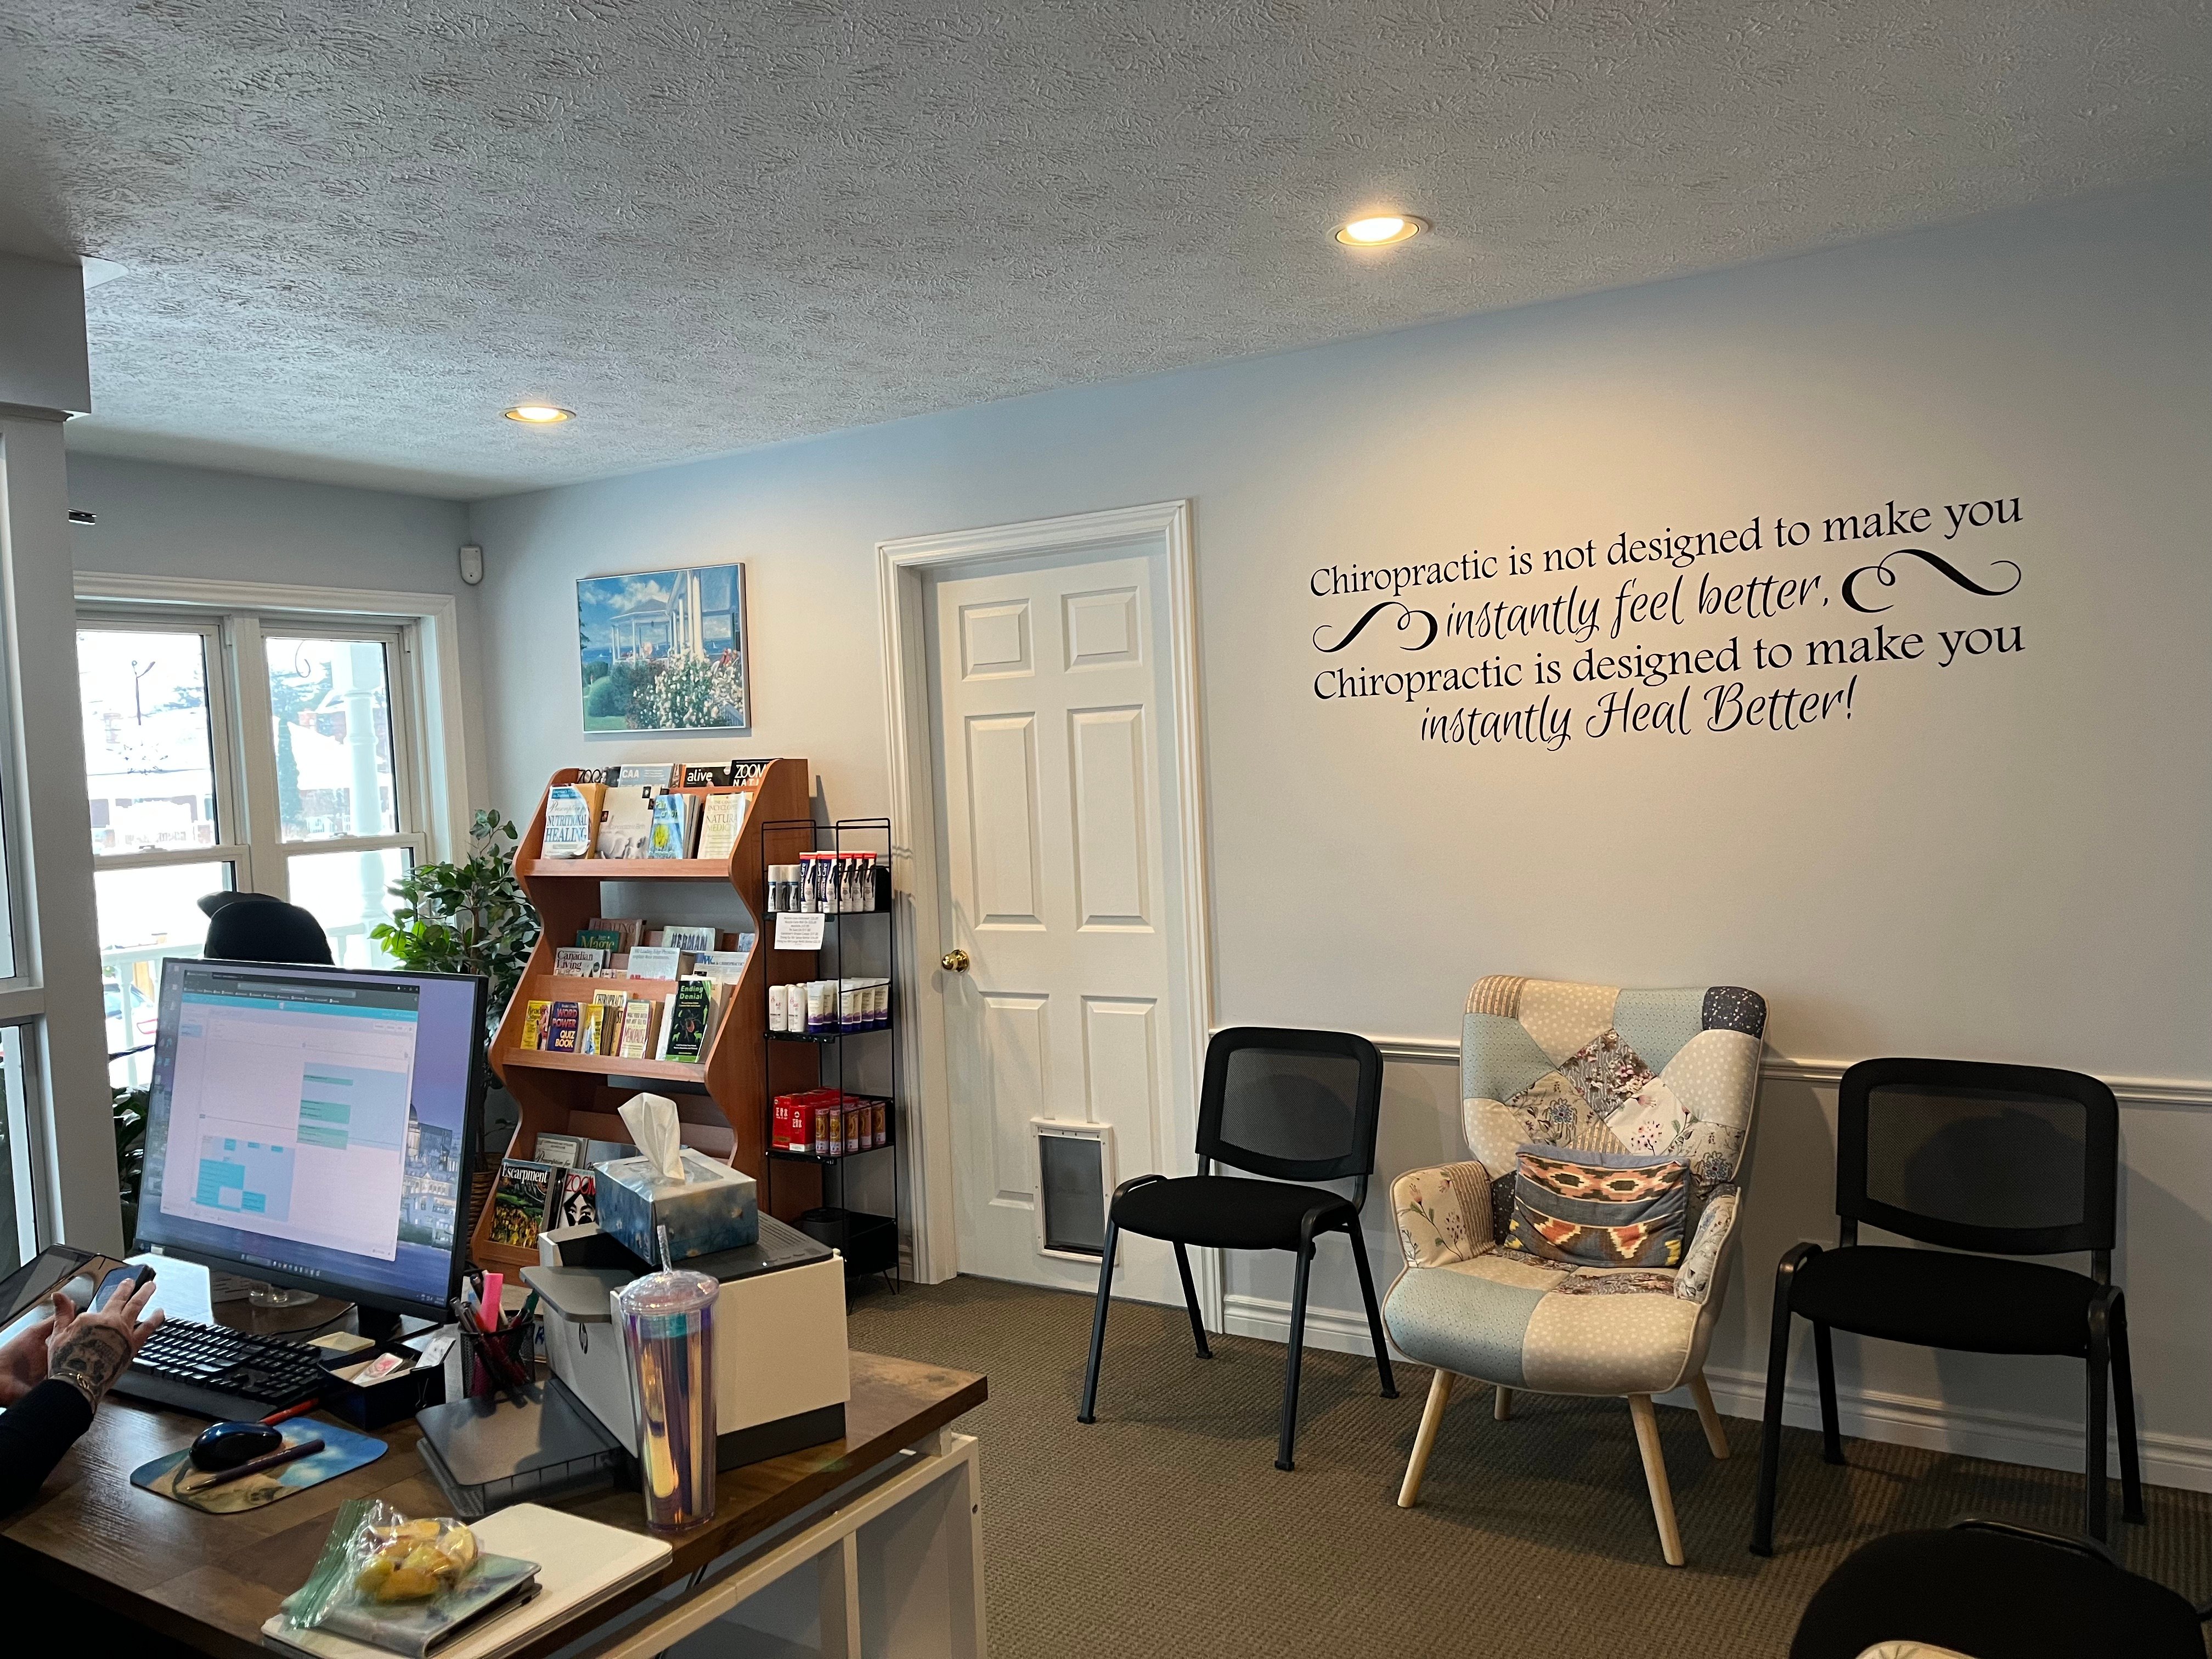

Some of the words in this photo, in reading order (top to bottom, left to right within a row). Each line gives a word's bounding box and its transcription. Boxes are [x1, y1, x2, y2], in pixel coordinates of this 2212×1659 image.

[1310, 550, 1498, 597] Chiropractic
[1508, 545, 1532, 575] is
[1543, 539, 1597, 572] not
[1607, 516, 1764, 568] designed
[1773, 517, 1810, 548] to
[1821, 500, 1932, 543] make
[1943, 497, 2024, 540] you
[1446, 585, 1600, 643] instantly
[1610, 574, 1685, 640] feel
[1698, 572, 1829, 619] better,
[1313, 656, 1523, 702] Chiropractic
[1534, 652, 1561, 684] is
[1572, 636, 1742, 687] designed
[1752, 639, 1793, 669] to
[1805, 624, 1925, 666] make
[1937, 625, 2027, 668] you
[1421, 693, 1572, 752] instantly
[1585, 685, 1692, 738] Heal
[1703, 674, 1858, 732] Better!
[577, 769, 603, 784] ZOO
[622, 769, 640, 778] CAA
[687, 769, 713, 782] alive
[546, 814, 588, 826] NUTRITIONAL
[706, 814, 738, 823] NATURA
[544, 827, 588, 843] HEALING
[670, 932, 708, 951] HERMAN
[557, 950, 594, 961] Canadian
[556, 960, 583, 970] Living
[595, 994, 624, 1006] CHIROPRACT
[557, 1008, 578, 1018] WORD
[552, 1018, 576, 1028] POWER
[560, 1030, 576, 1039] QUIZ
[555, 1039, 574, 1048] BOOK
[501, 1161, 549, 1184] Escarpment
